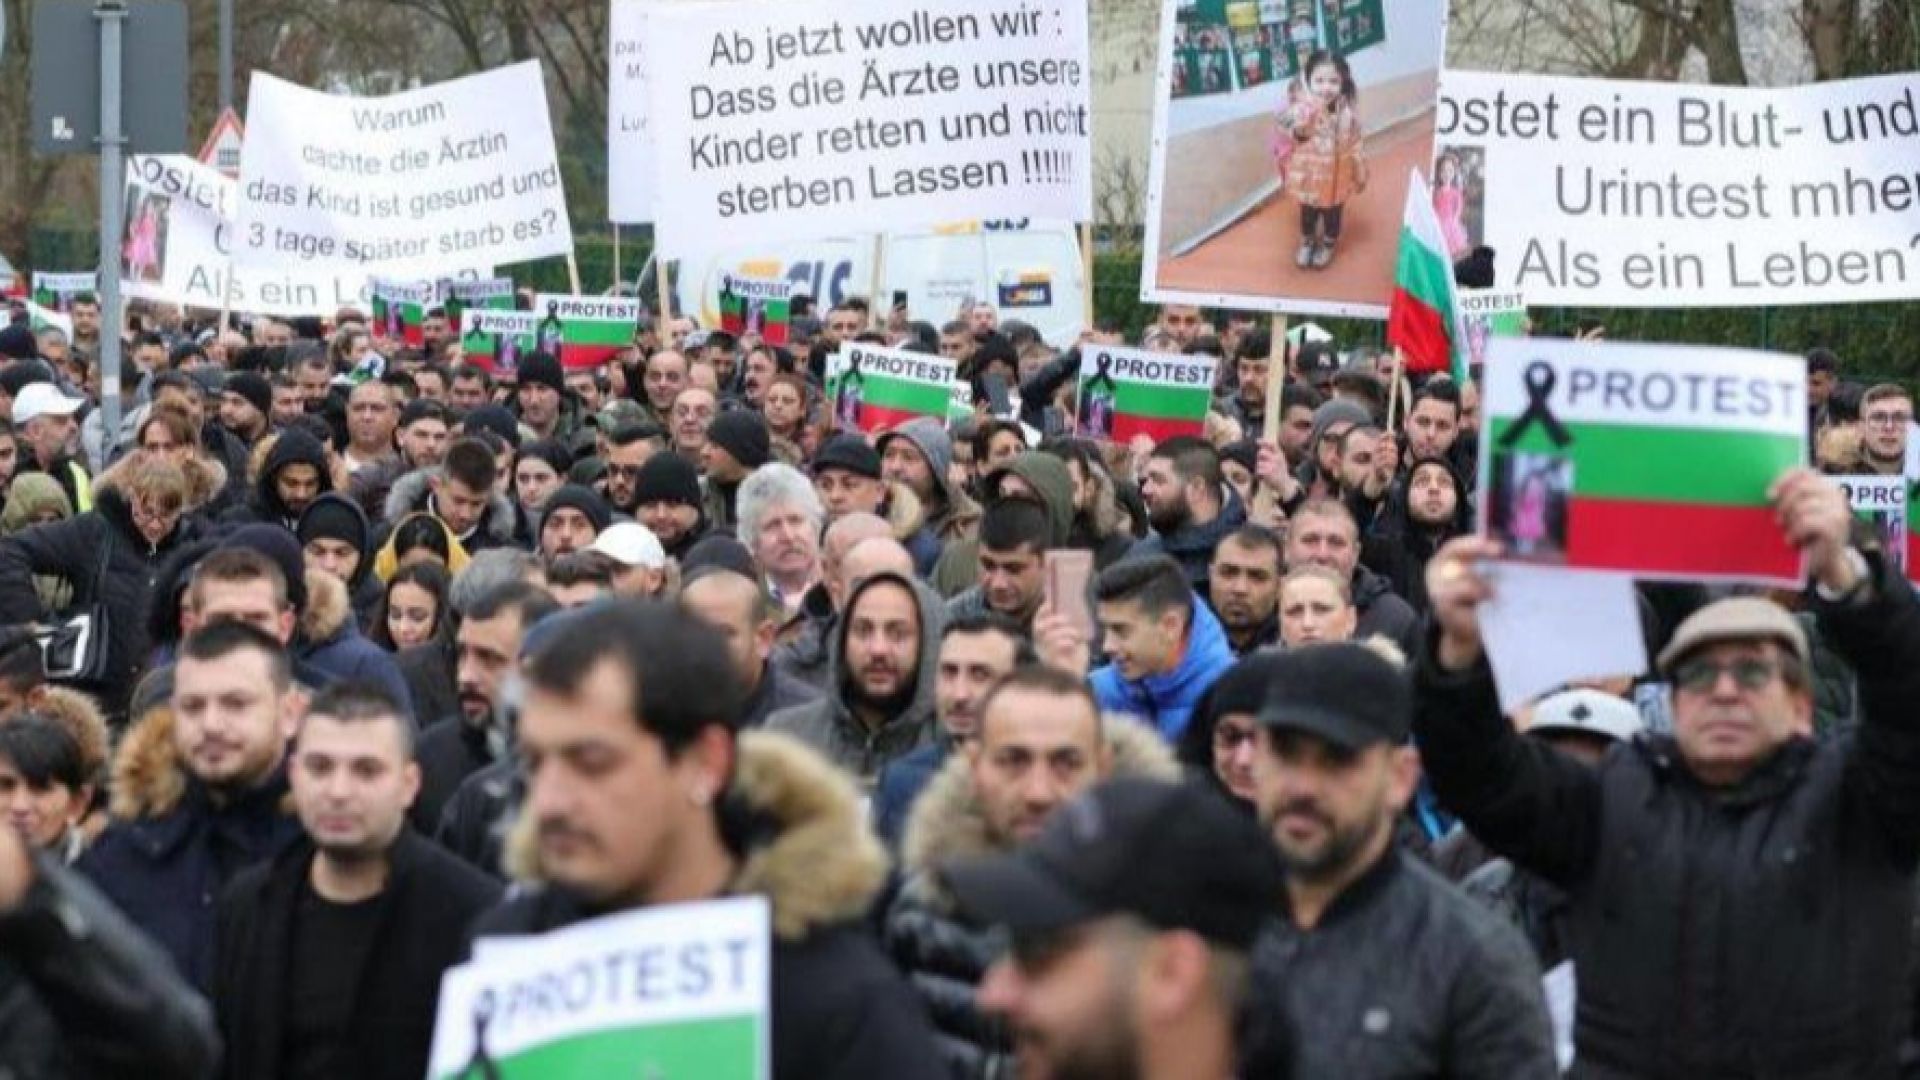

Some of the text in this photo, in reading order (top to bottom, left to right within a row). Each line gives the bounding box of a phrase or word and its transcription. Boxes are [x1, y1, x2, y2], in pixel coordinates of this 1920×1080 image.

[709, 32, 755, 67] Ab
[765, 20, 844, 70] jetzt
[856, 9, 980, 50] wollen
[991, 2, 1042, 38] wir
[352, 99, 445, 131] Warum
[690, 58, 1081, 120] Dass die Ärzte unsere
[690, 100, 1088, 171] Kinder retten und nicht
[1577, 93, 1656, 145] ein
[1678, 97, 1804, 149] Blut-
[1822, 86, 1920, 144] und
[390, 148, 430, 174] die
[246, 165, 557, 219] das Kind ist gesund und
[717, 175, 855, 217] sterben
[868, 160, 1009, 201] Lassen
[1555, 164, 1773, 220] Urintest
[248, 221, 265, 248] 3
[274, 226, 336, 261] tage
[344, 234, 430, 266] später
[438, 220, 505, 255] starb
[513, 207, 558, 242] es?
[1514, 237, 1602, 289] Als
[1622, 241, 1705, 291] ein
[259, 277, 318, 306] ein
[561, 301, 636, 319] PROTEST
[863, 351, 953, 385] PROTEST
[1115, 356, 1213, 385] PROTEST
[1566, 367, 1799, 419] PROTEST
[502, 939, 750, 1024] PROTEST
